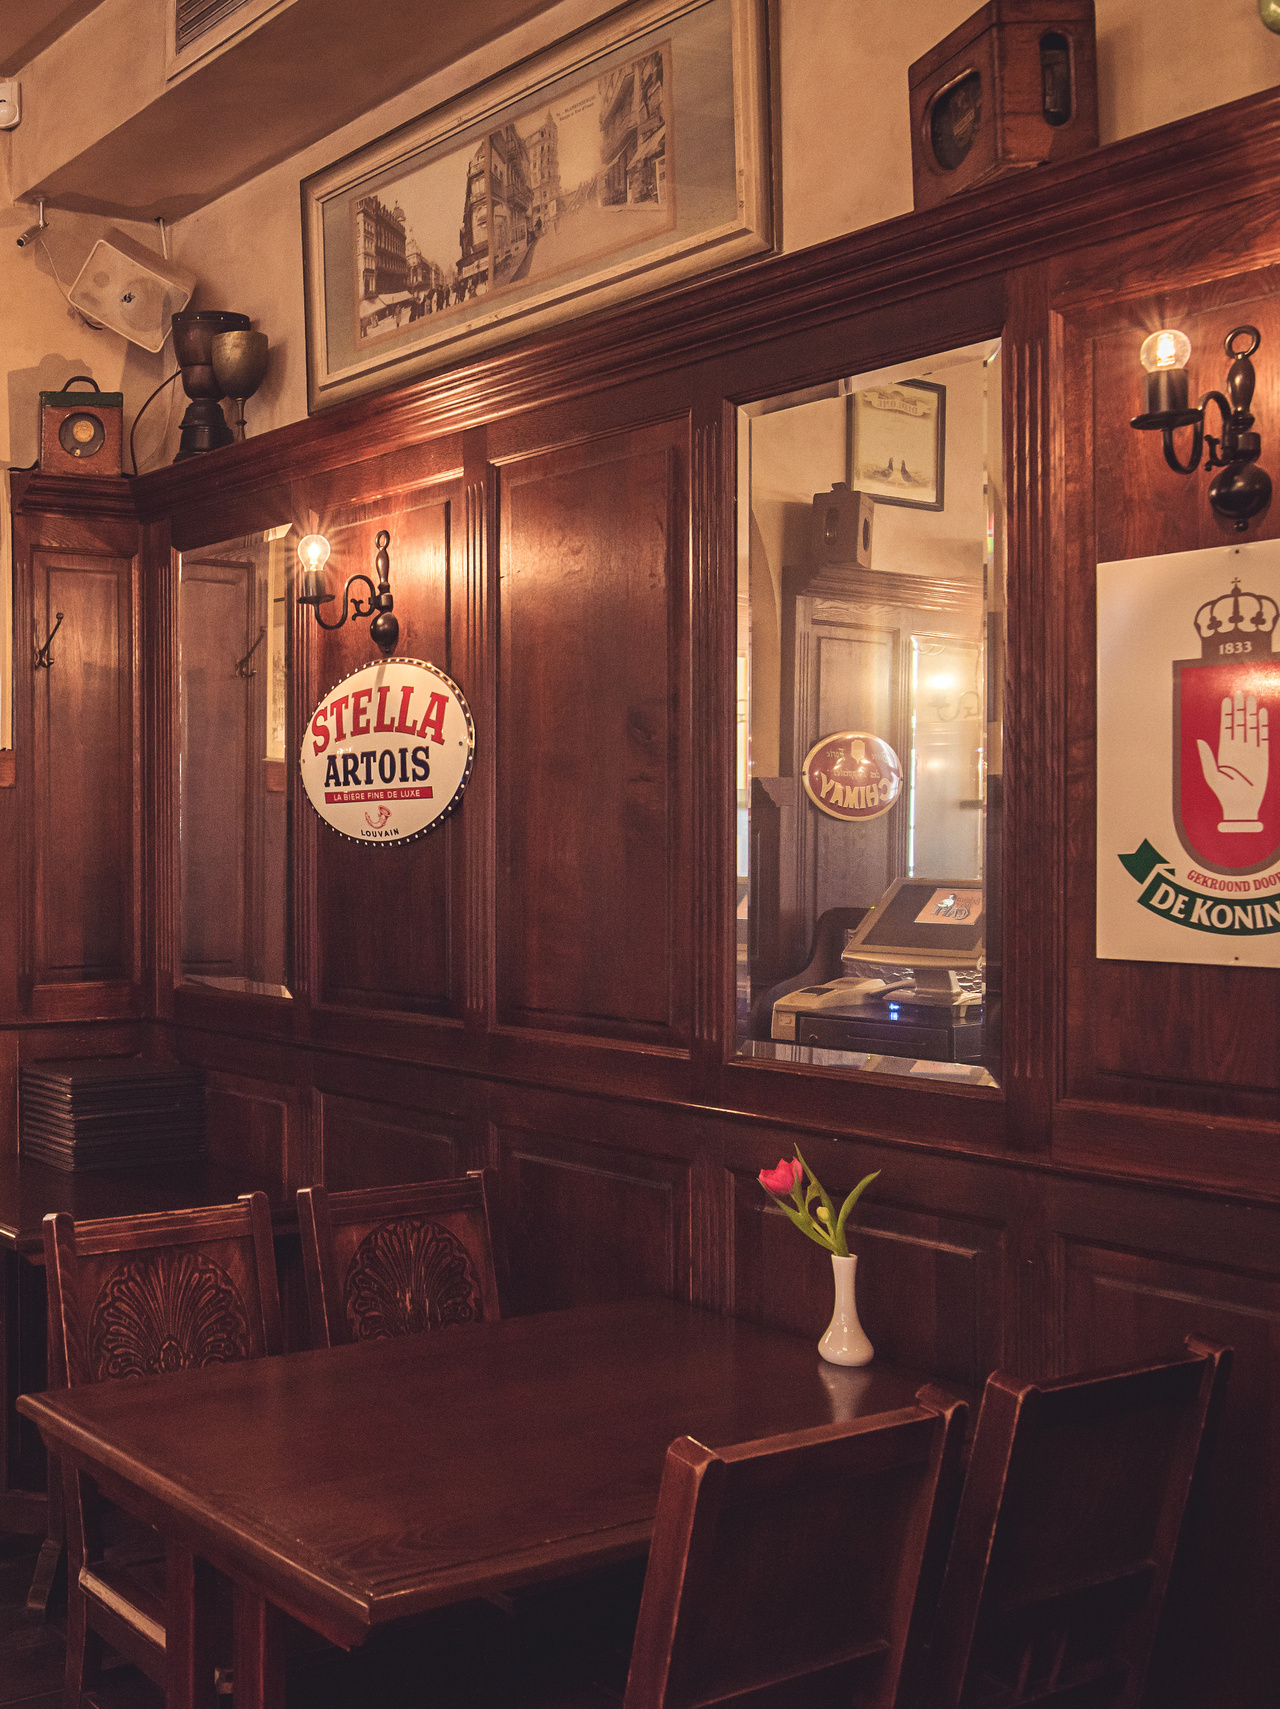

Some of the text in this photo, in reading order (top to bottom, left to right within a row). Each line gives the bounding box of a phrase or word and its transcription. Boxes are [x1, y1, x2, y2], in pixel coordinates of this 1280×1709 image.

[1219, 641, 1252, 655] 1833
[311, 686, 449, 756] STELLA
[324, 746, 430, 788] ARTOIS
[367, 791, 384, 799] FINE
[387, 790, 397, 798] DE
[401, 789, 420, 797] LUXE
[361, 828, 399, 837] LOUVAIN
[1187, 869, 1251, 892] GEKROOND
[1149, 882, 1280, 930] DE KONIN
